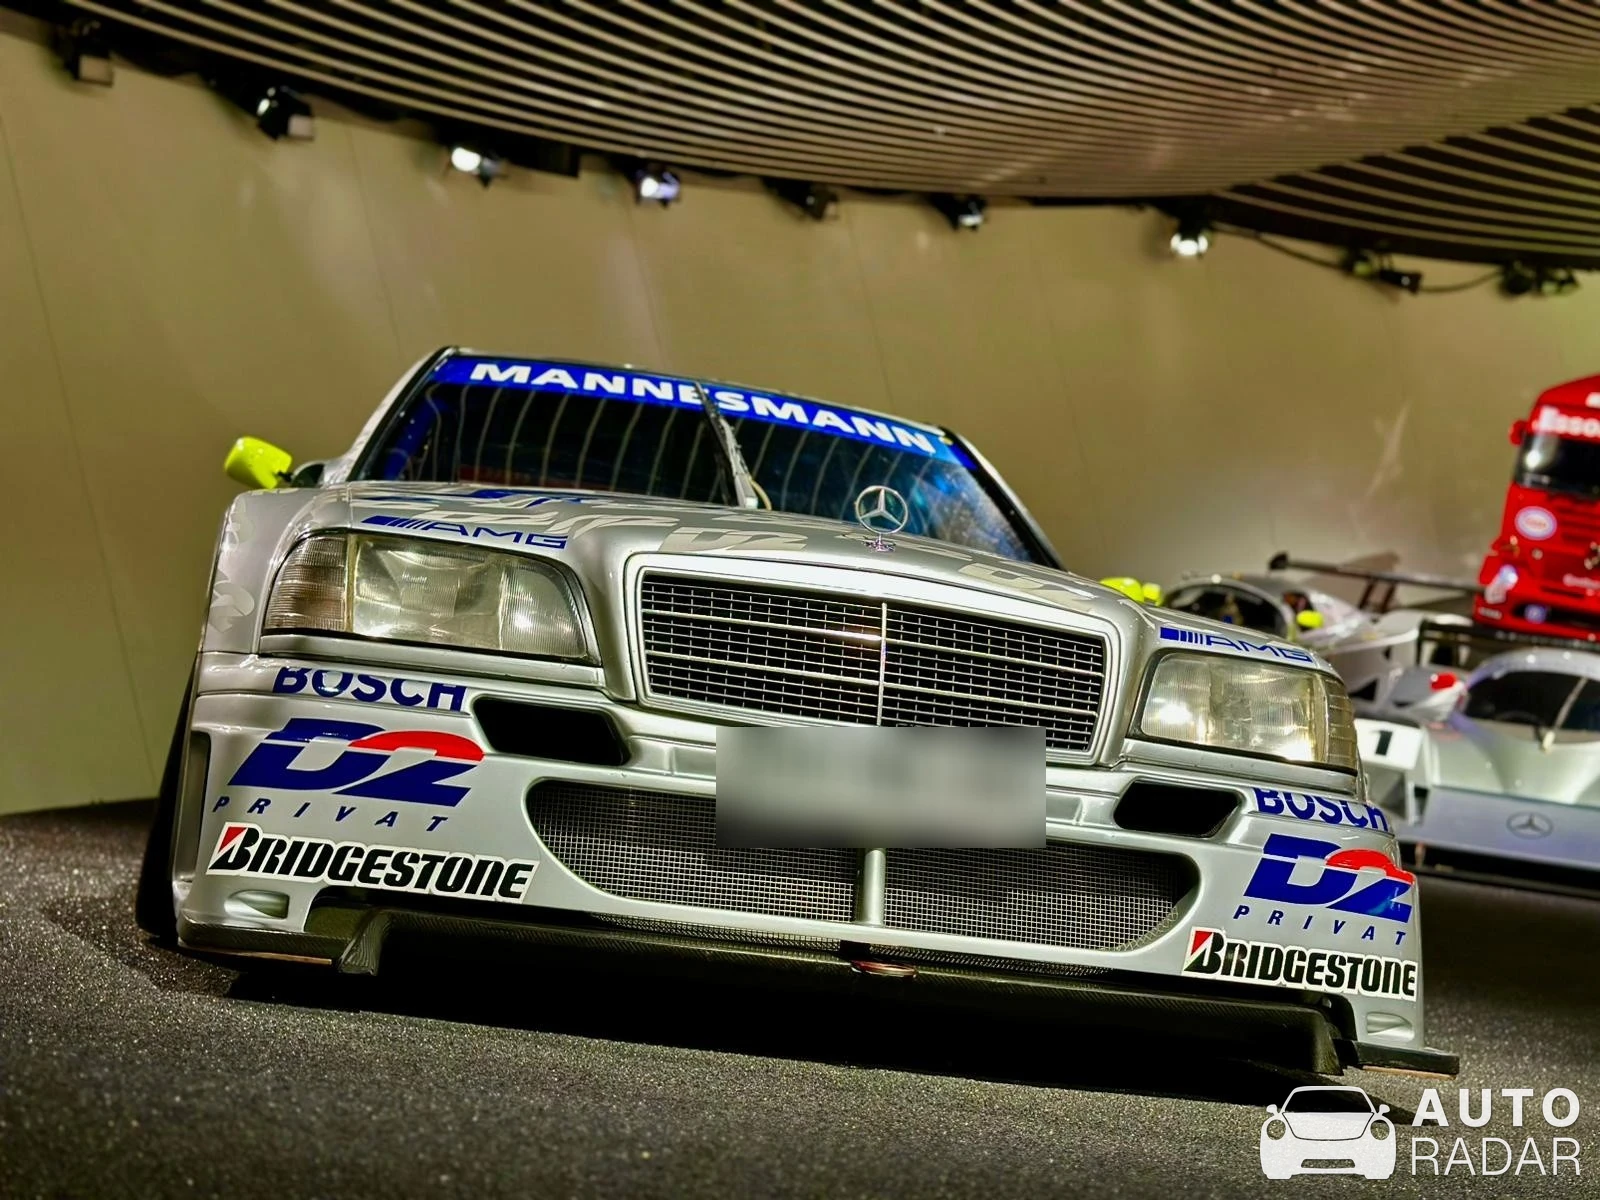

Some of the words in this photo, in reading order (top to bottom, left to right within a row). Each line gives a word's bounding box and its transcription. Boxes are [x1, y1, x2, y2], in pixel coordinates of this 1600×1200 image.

[470, 362, 933, 455] MANNESMANN
[418, 520, 570, 551] AMG
[1205, 634, 1314, 663] AMG
[272, 667, 468, 712] BOSCH
[227, 717, 485, 808] D2
[1374, 729, 1394, 756] 1
[1253, 787, 1391, 831] BOSCH
[207, 825, 536, 900] BRIDGESTONE
[1243, 833, 1415, 923] D2
[1183, 929, 1417, 997] BRIDGESTONE
